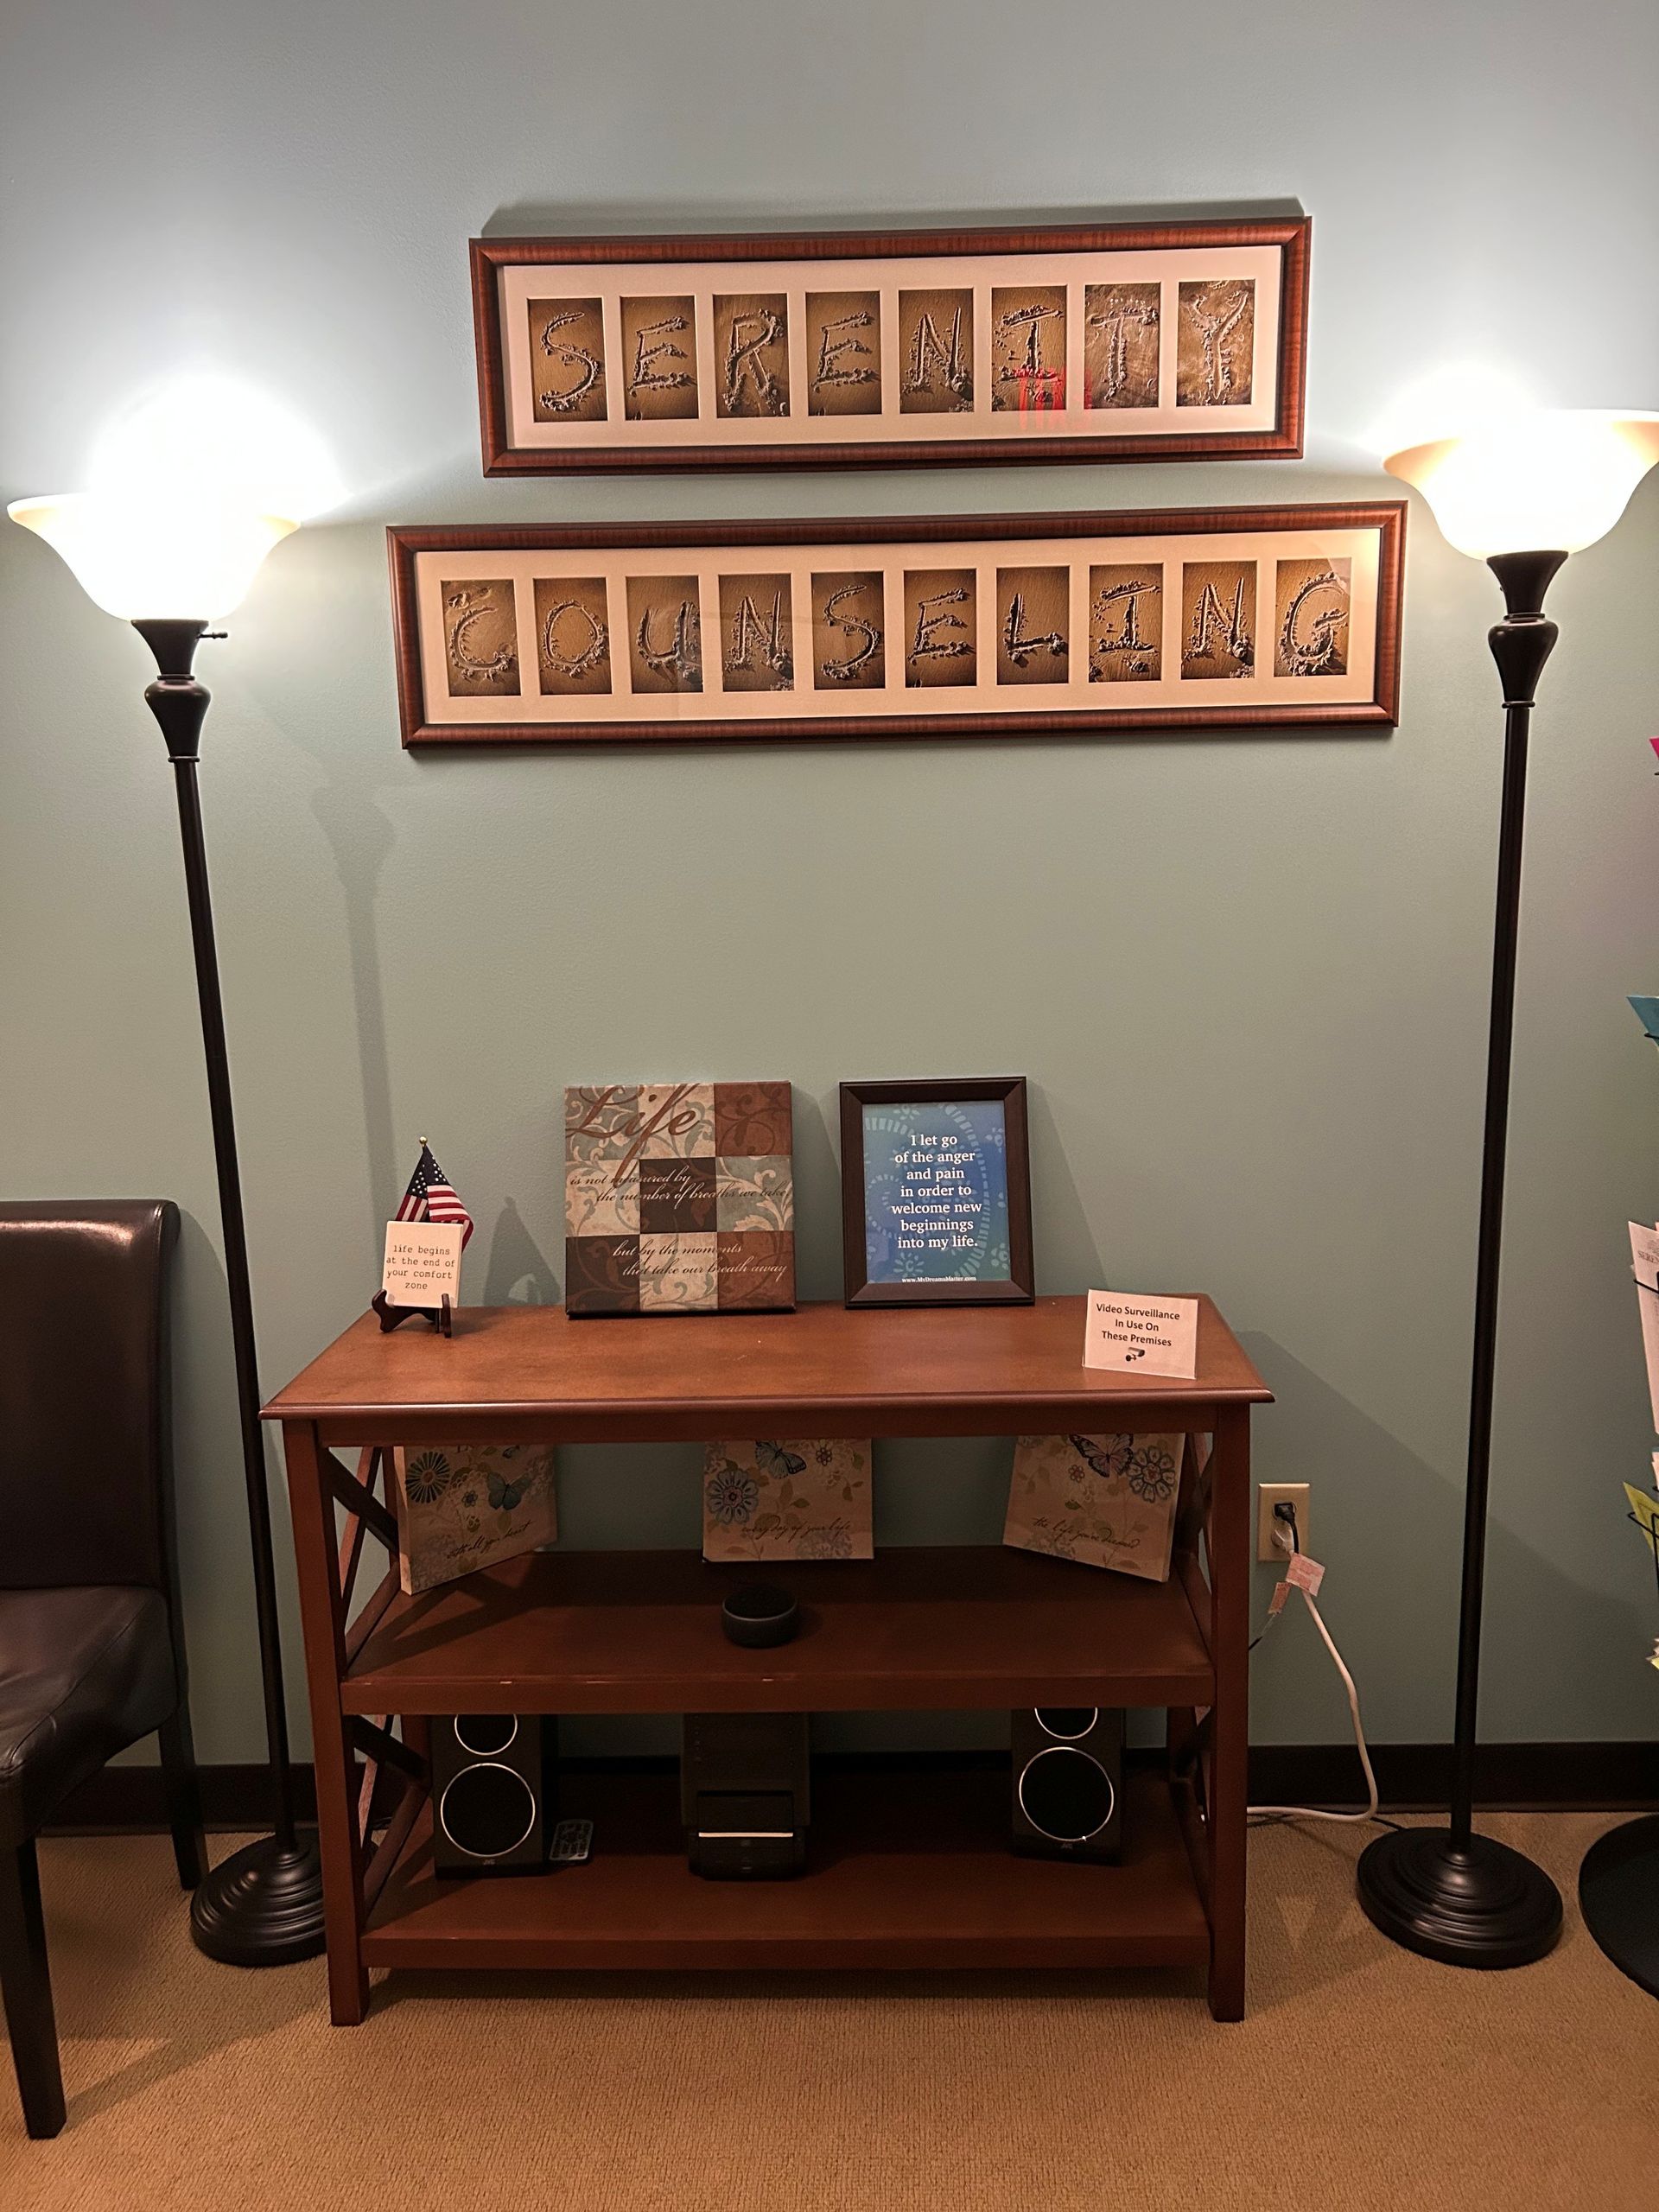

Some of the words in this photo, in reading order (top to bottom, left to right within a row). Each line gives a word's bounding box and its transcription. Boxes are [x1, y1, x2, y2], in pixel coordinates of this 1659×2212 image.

[537, 290, 1249, 411] SERENITY
[448, 578, 1350, 681] COUNSELING
[565, 1084, 700, 1188] Life
[911, 1135, 917, 1146] I
[920, 1135, 938, 1146] let
[942, 1136, 958, 1148] go
[894, 1151, 909, 1163] of
[912, 1151, 933, 1162] the
[937, 1152, 976, 1164] anger
[570, 1175, 582, 1185] is
[585, 1174, 608, 1185] not
[674, 1166, 692, 1192] by
[906, 1168, 931, 1179] and
[935, 1168, 964, 1181] pain
[596, 1185, 618, 1203] the
[620, 1183, 671, 1201] number
[674, 1182, 696, 1210] of
[690, 1180, 737, 1198] breaths
[739, 1189, 758, 1198] we
[900, 1186, 913, 1197] in
[918, 1185, 954, 1197] order
[958, 1186, 972, 1196] to
[891, 1203, 950, 1214] welcome
[954, 1203, 982, 1212] new
[900, 1219, 974, 1233] beginnings
[393, 1244, 413, 1253] life
[418, 1245, 450, 1256] begins
[898, 1237, 925, 1249] into
[928, 1238, 949, 1250] my
[952, 1236, 978, 1247] life.
[613, 1239, 636, 1256] but
[639, 1240, 658, 1266] by
[659, 1239, 680, 1255] the
[683, 1243, 742, 1254] moments
[402, 1257, 419, 1266] the
[423, 1258, 441, 1268] end
[445, 1259, 455, 1268] of
[623, 1261, 650, 1276] that
[652, 1256, 679, 1274] take
[683, 1266, 705, 1274] our
[708, 1255, 754, 1274] breath
[751, 1265, 787, 1283] away
[386, 1269, 409, 1279] your
[413, 1270, 453, 1280] comfort
[1096, 1303, 1122, 1314] Video
[1124, 1306, 1180, 1320] Surveillance
[1115, 1319, 1123, 1327] In
[1126, 1320, 1144, 1330] Use
[1145, 1322, 1160, 1332] On
[1102, 1331, 1128, 1342] These
[1130, 1333, 1172, 1346] Premises
[1031, 1516, 1048, 1529] the
[468, 1535, 486, 1553] all
